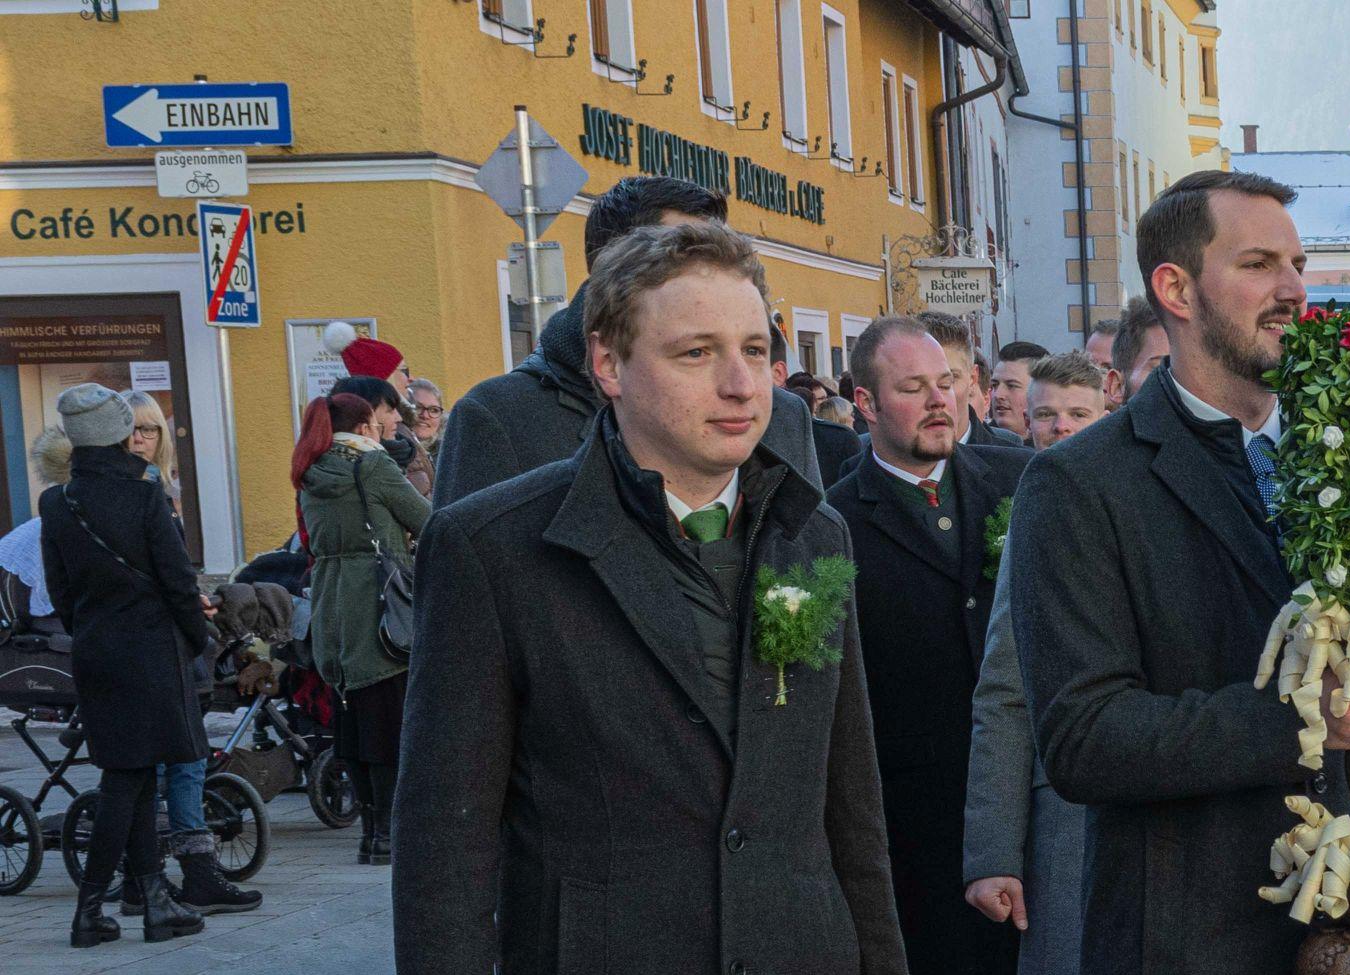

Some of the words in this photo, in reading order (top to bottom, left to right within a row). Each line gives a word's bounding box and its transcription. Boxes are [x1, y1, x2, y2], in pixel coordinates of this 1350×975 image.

[166, 102, 270, 128] EINBAHN
[579, 103, 634, 167] JOSEF
[159, 154, 243, 169] ausgenommen
[10, 207, 95, 240] Café
[232, 264, 248, 286] 20
[930, 279, 980, 291] Bäckerei
[216, 296, 249, 317] Zone
[925, 290, 986, 304] Hochleitner
[0, 325, 68, 338] HIMMLISCHE
[71, 323, 161, 336] VERFÜHRUNGEN
